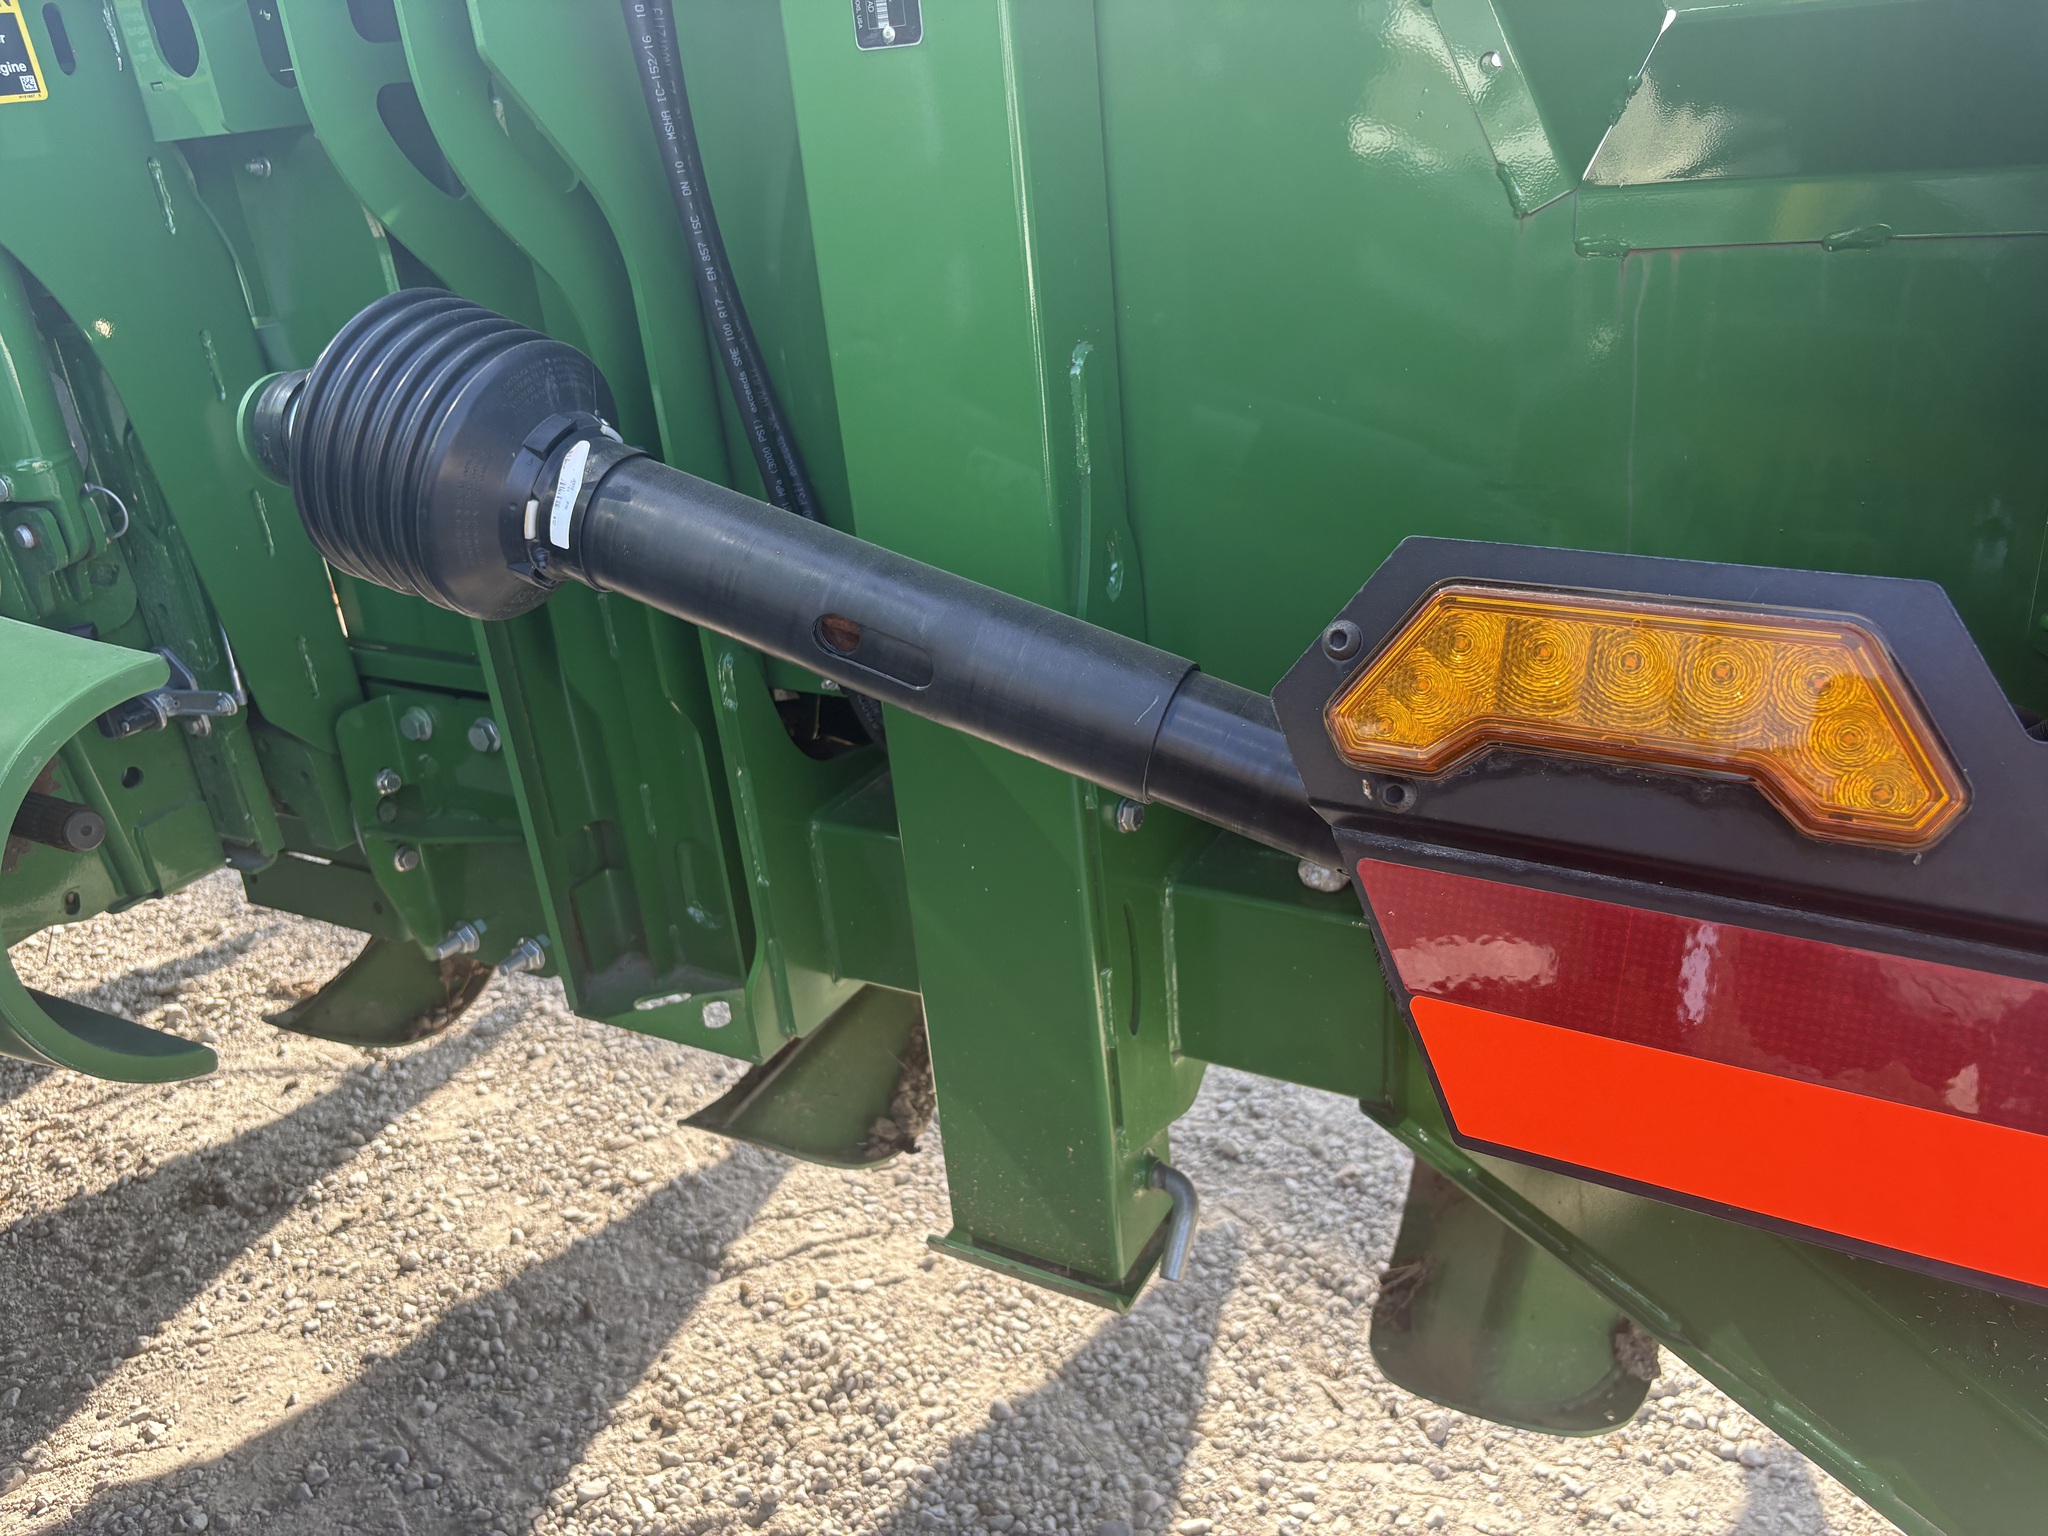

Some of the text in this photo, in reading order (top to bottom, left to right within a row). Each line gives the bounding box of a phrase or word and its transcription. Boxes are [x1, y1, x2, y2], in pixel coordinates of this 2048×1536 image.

[0, 61, 27, 76] gine
[642, 35, 667, 103] IC-152/16
[660, 110, 677, 141] MSHA
[674, 160, 686, 174] 10
[680, 181, 693, 197] DN
[697, 243, 711, 262] 857
[705, 268, 717, 282] EN
[715, 299, 729, 319] R17
[722, 324, 735, 341] 100
[730, 347, 743, 367] SAE
[738, 371, 758, 414] exceeds
[752, 420, 767, 443] PSI)
[762, 446, 778, 475] (3000
[775, 479, 787, 498] MPa
